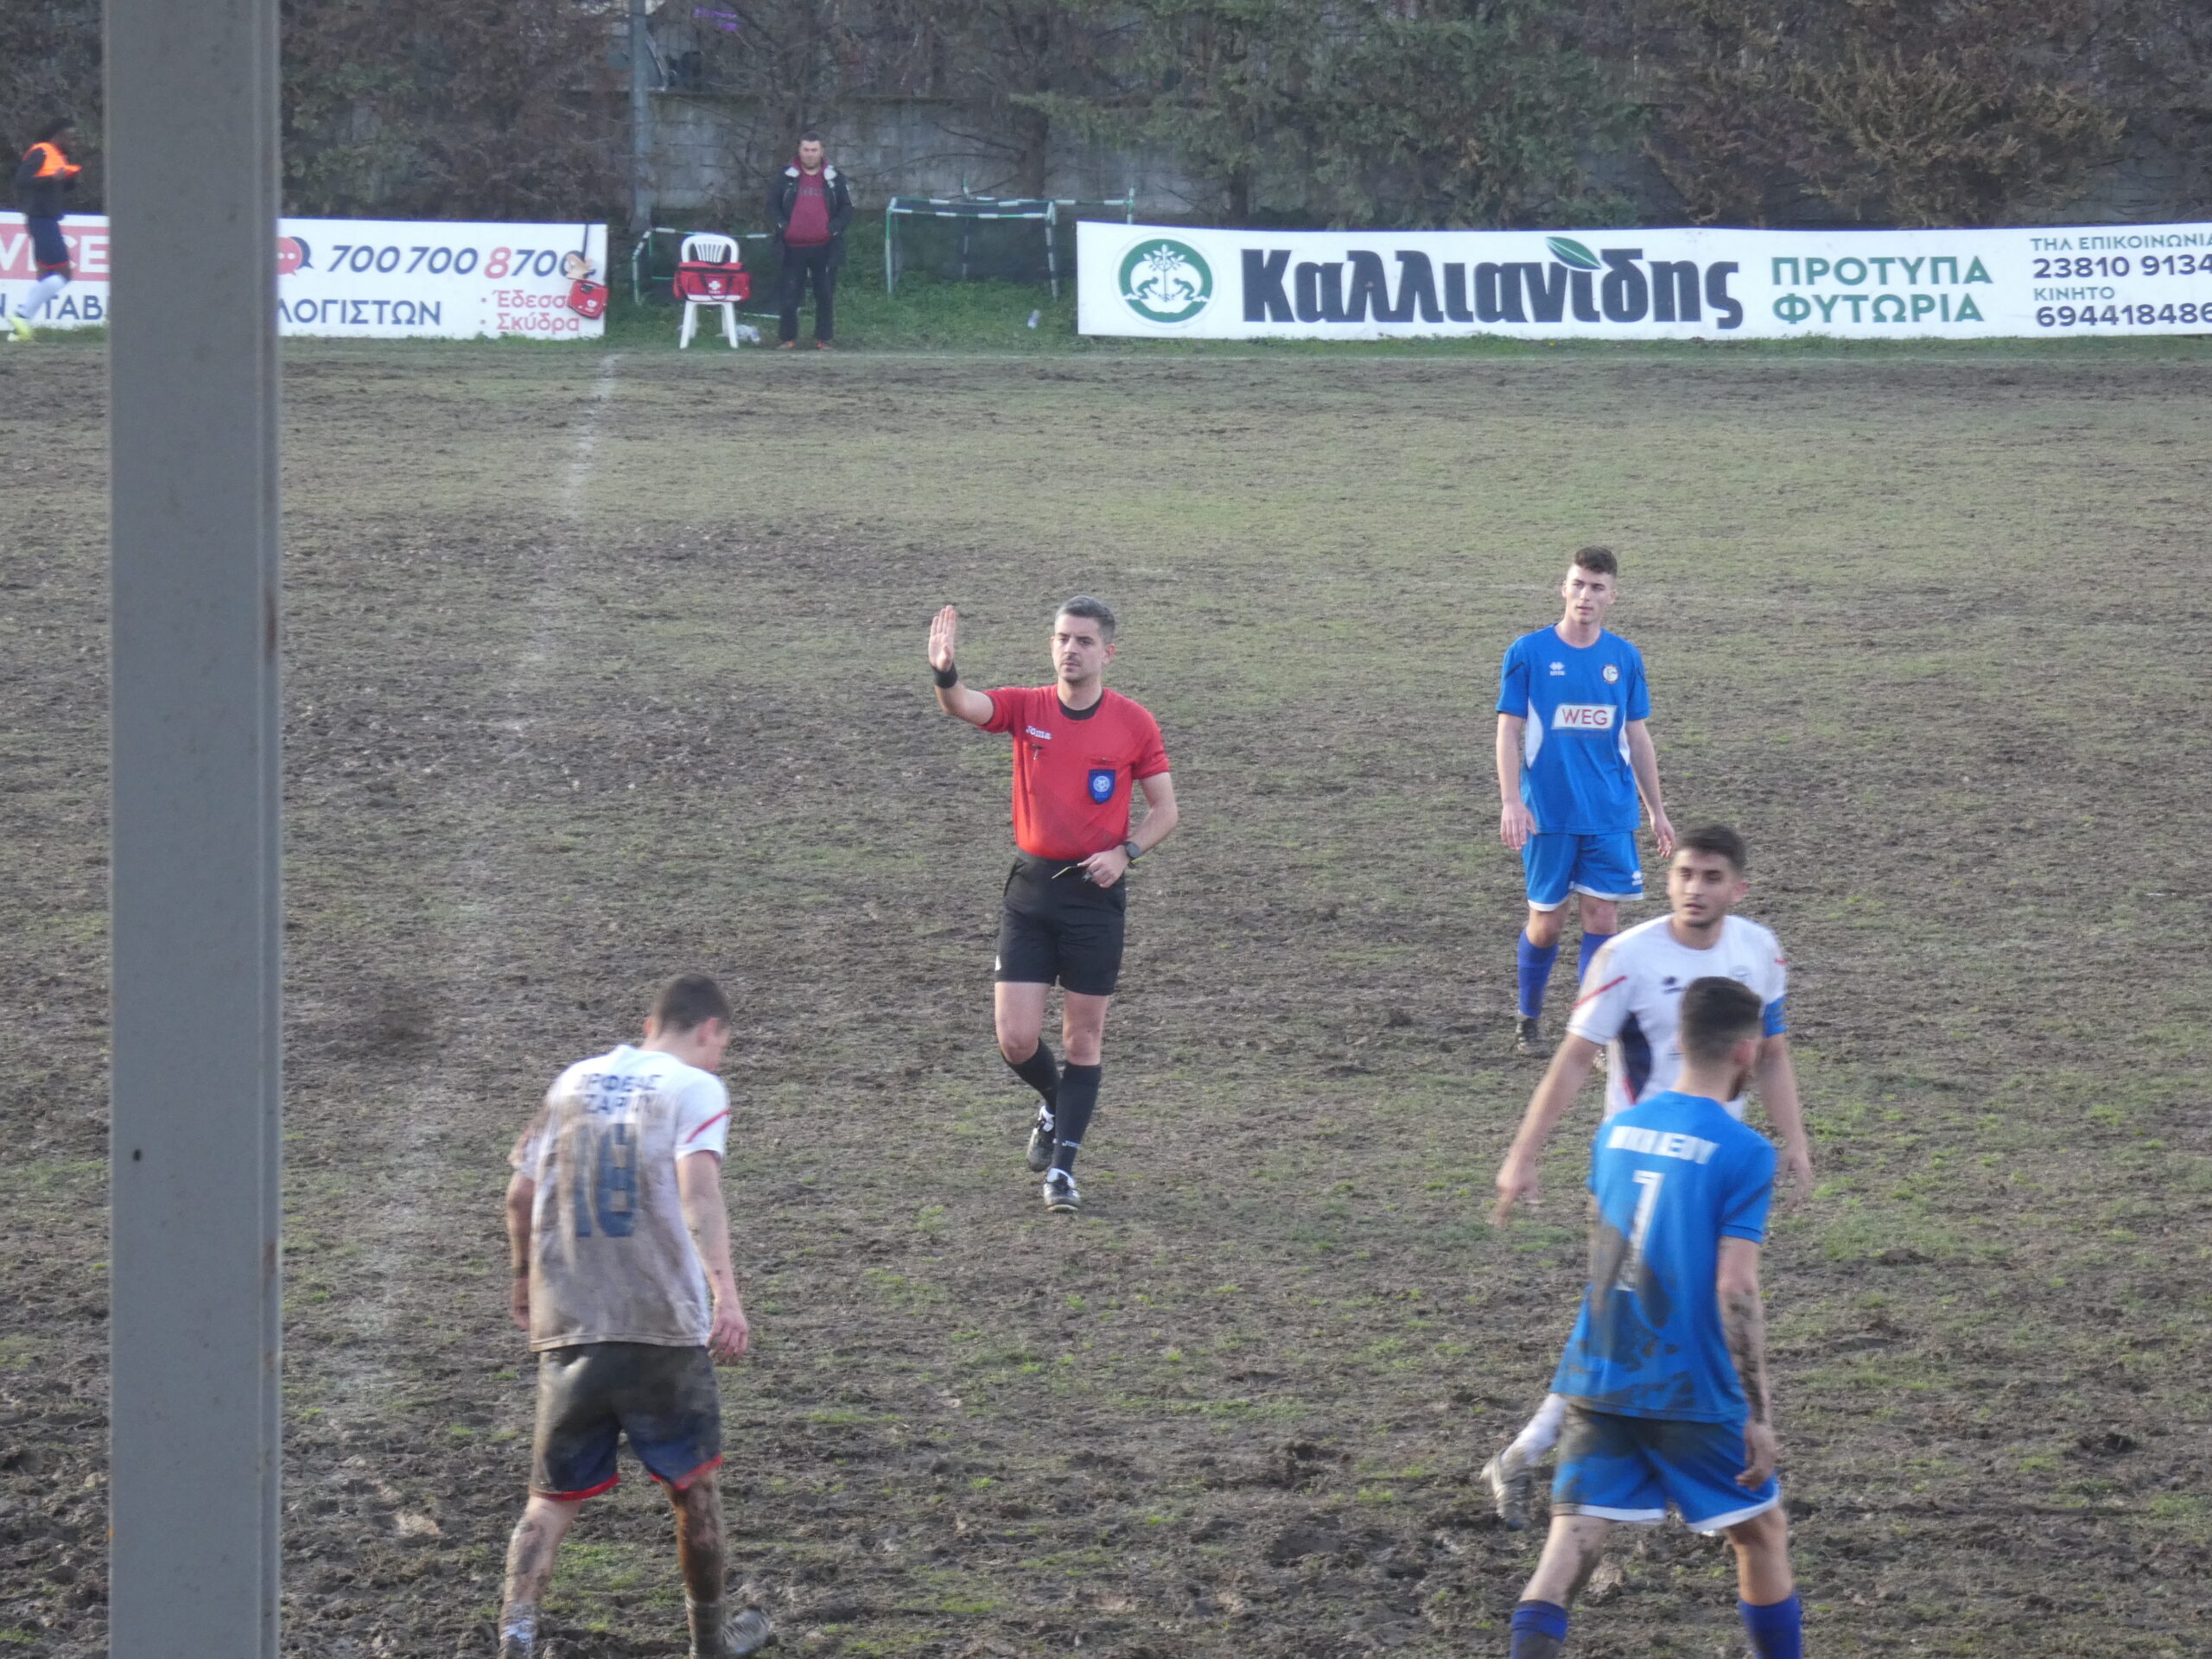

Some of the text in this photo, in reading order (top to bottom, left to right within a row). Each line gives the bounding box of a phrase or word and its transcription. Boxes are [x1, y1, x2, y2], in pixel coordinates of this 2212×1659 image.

[2031, 237, 2073, 251] ΤΗΛ
[1771, 256, 1993, 286] ΠΡΟΤΥΠΑ
[2032, 256, 2130, 279] 23810
[2033, 286, 2115, 301] ΚΙΝΗΤΟ
[1772, 292, 1985, 324] ΦΥΤΩΡΙΑ
[2036, 302, 2212, 327] 694418486
[496, 312, 580, 334] Σκύδρα
[1562, 709, 1608, 726] WEG
